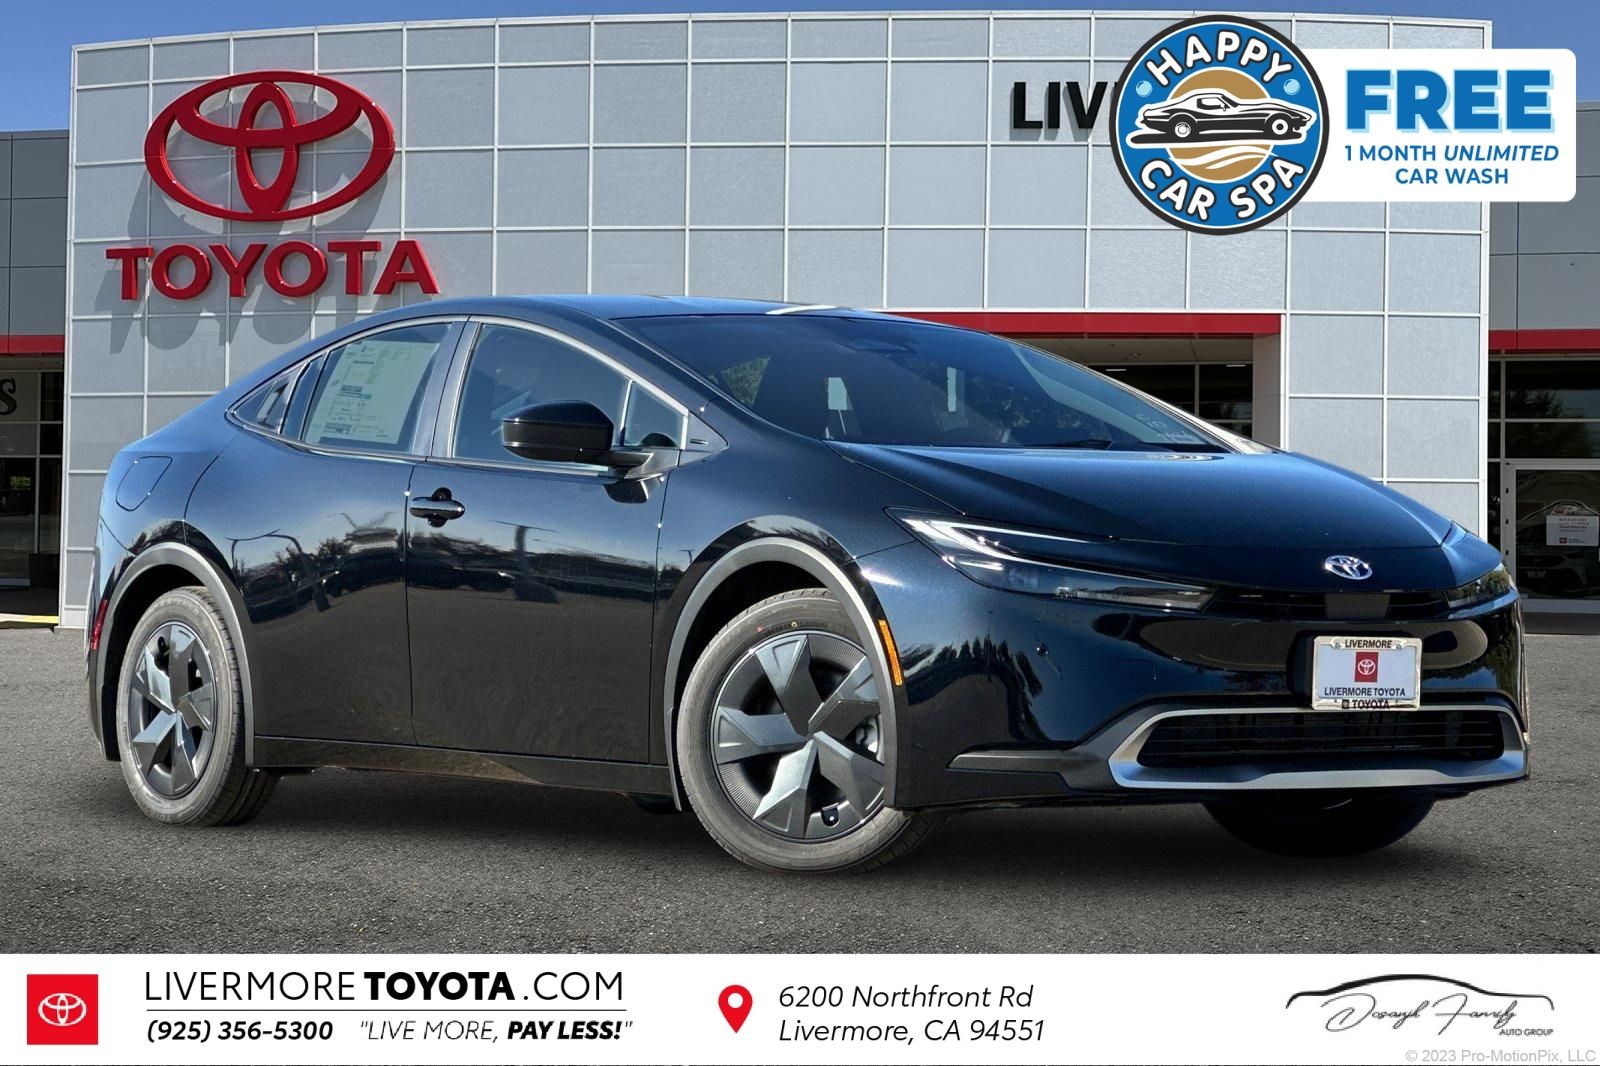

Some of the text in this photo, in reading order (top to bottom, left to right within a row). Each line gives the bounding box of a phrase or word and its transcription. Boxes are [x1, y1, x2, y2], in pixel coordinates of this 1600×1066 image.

[1013, 81, 1119, 129] LIV
[106, 240, 440, 300] TOYOTA
[1344, 639, 1393, 649] LIVERMORE
[1324, 687, 1406, 697] LIVERMORE TOYOTA
[1351, 699, 1390, 710] TOYOTA
